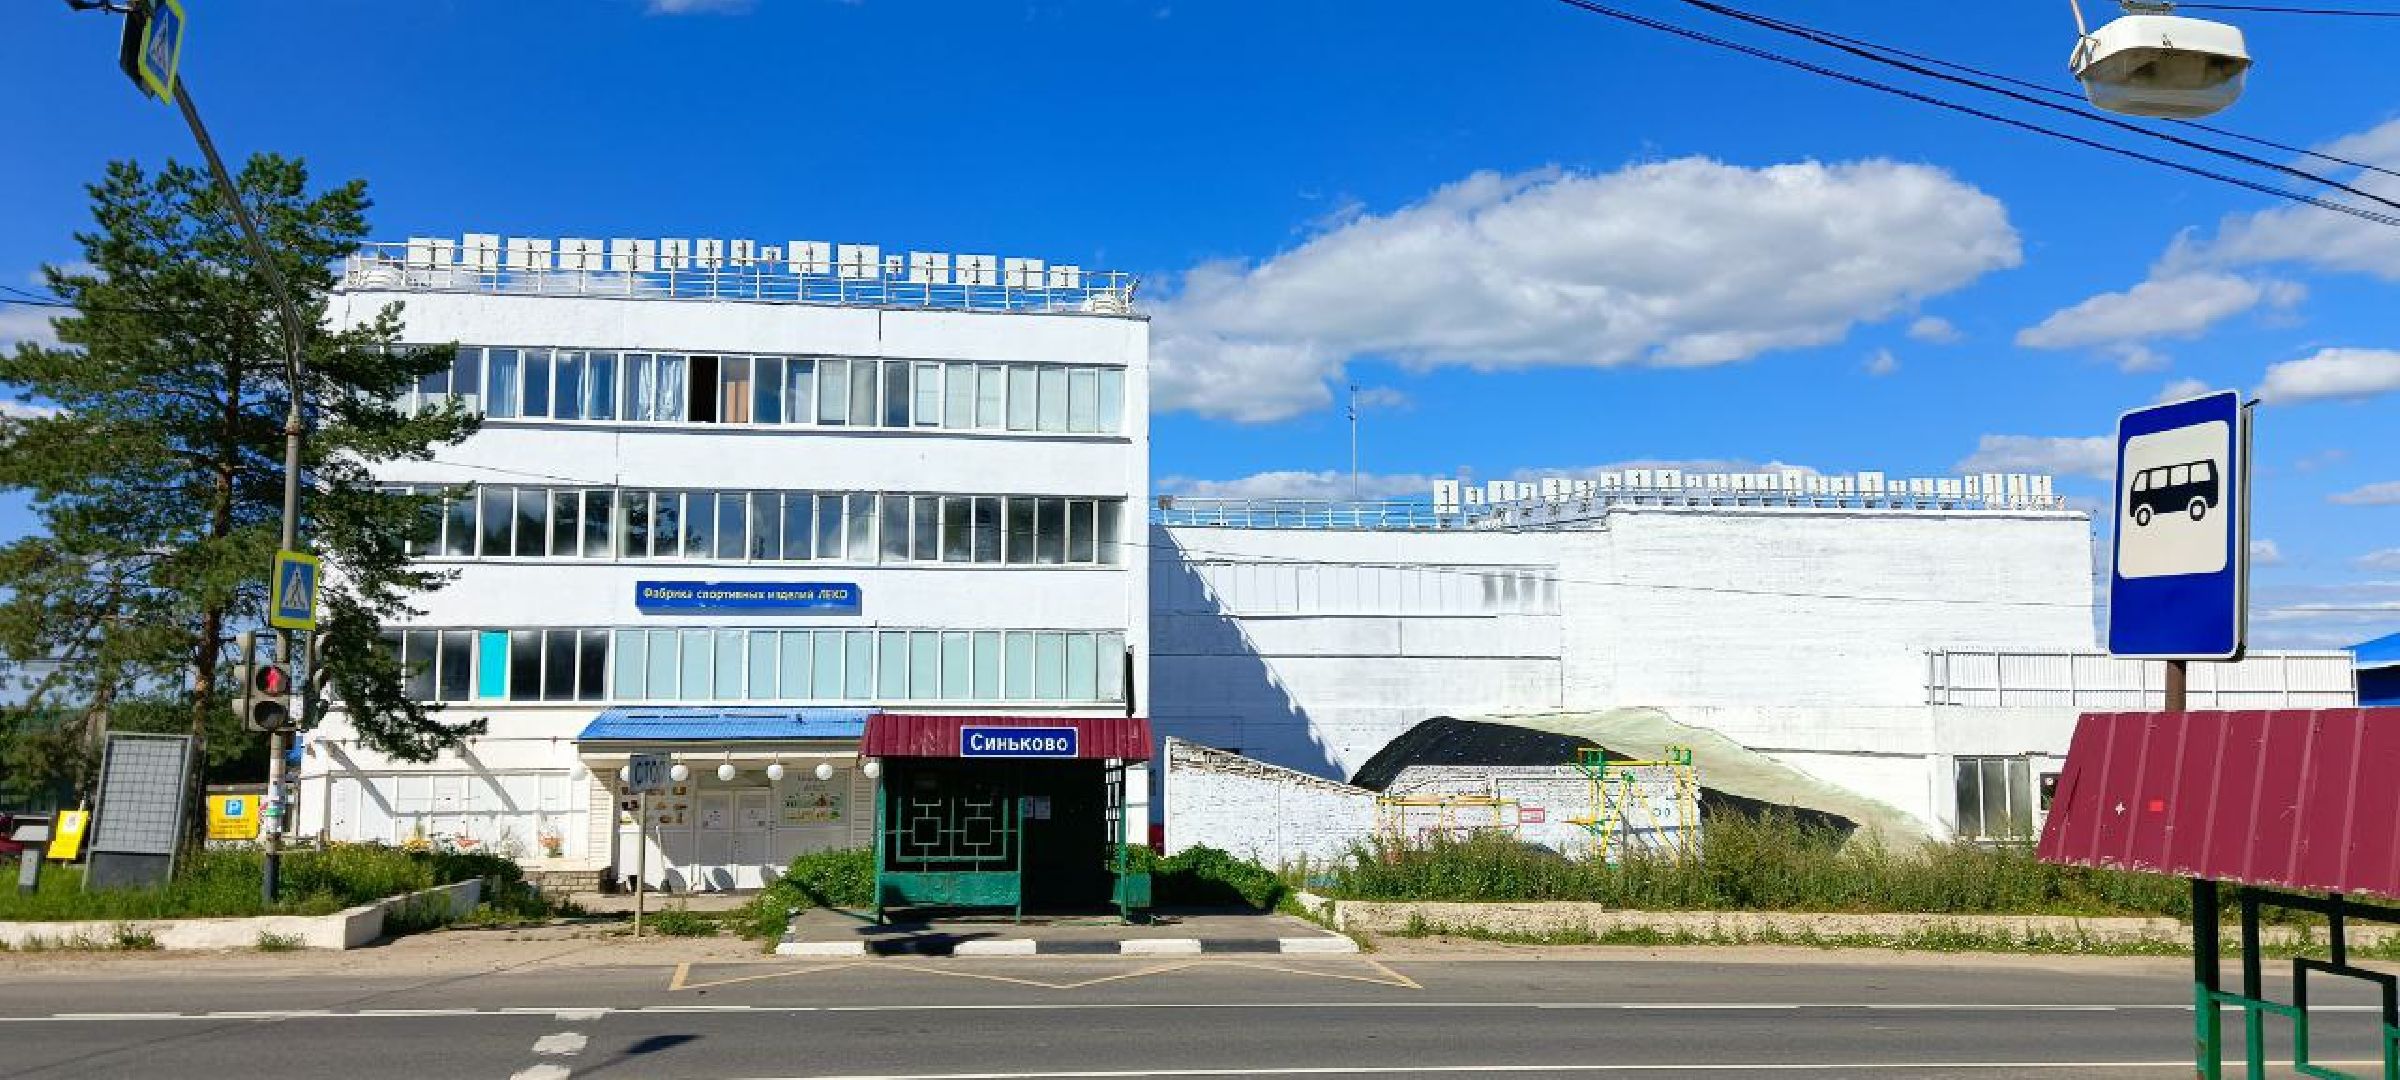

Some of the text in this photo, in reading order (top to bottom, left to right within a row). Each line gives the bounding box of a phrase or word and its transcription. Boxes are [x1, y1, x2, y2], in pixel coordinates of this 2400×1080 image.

[644, 587, 692, 600] Фабрика
[696, 589, 765, 601] спортивных
[767, 589, 814, 601] изделий
[970, 732, 1069, 751] Синьково
